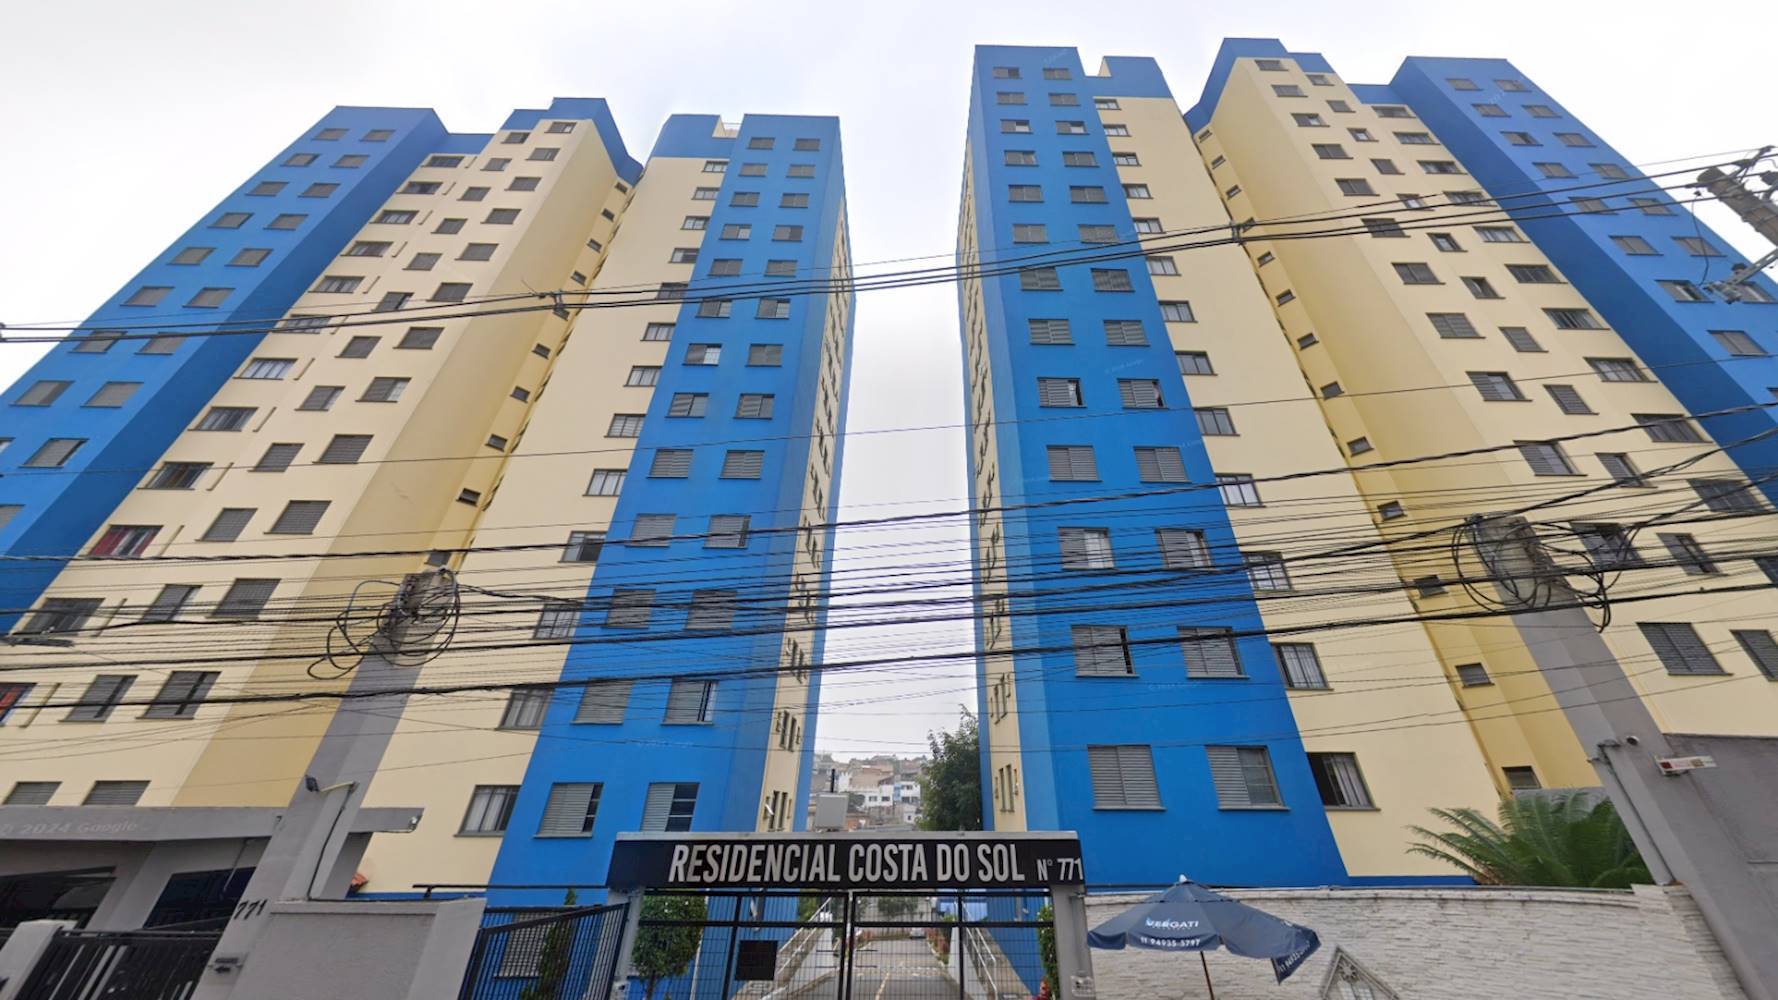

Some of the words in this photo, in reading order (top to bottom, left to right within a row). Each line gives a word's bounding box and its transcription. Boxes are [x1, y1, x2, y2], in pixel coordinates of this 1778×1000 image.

[668, 844, 841, 882] RESIDENCIAL
[848, 844, 928, 882] COSTA
[937, 844, 970, 882] DO
[977, 844, 1025, 882] SOL
[1056, 857, 1084, 881] 771
[233, 899, 268, 920] 771
